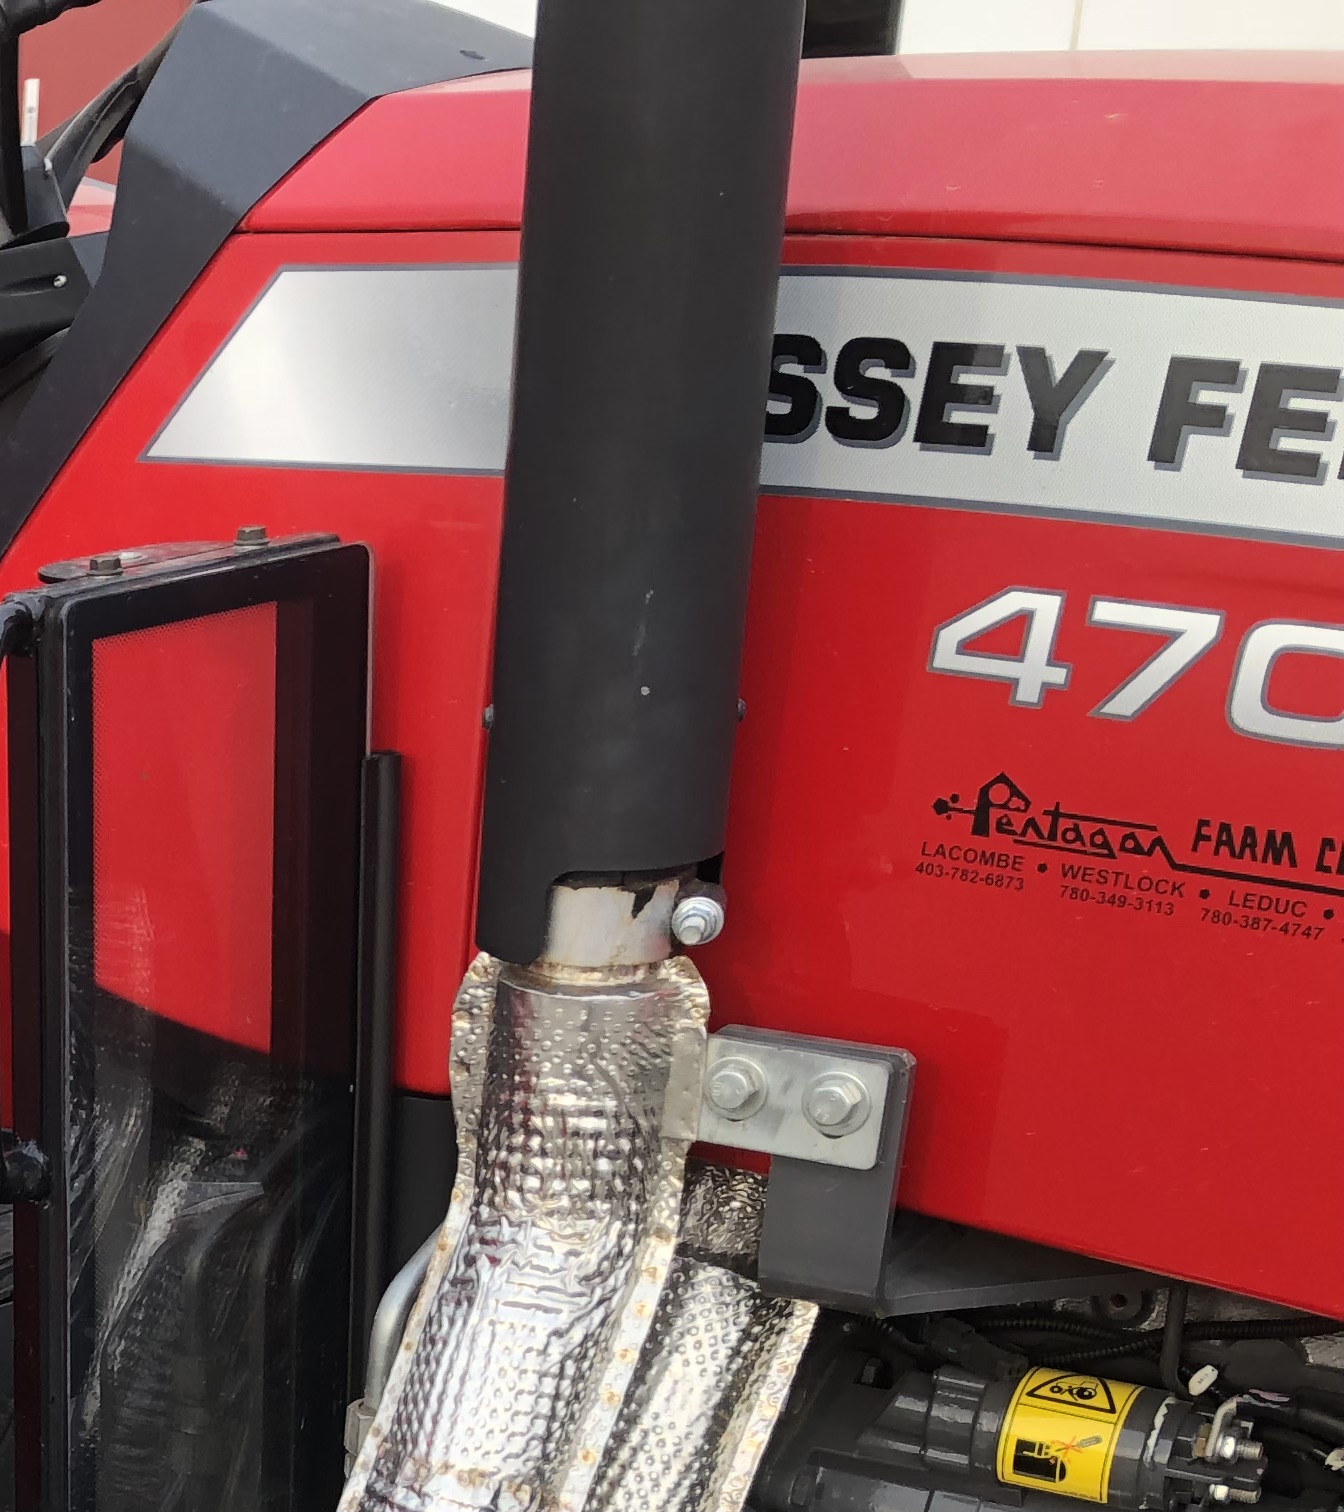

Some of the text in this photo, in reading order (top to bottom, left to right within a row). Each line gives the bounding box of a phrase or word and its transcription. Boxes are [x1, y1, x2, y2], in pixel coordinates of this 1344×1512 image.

[764, 333, 1344, 486] SSEY FE
[914, 861, 1326, 941] 403-782-6873 780-349-3113 780-387-4747
[920, 841, 1308, 919] LACOMBE WESTLOCK LEDUC
